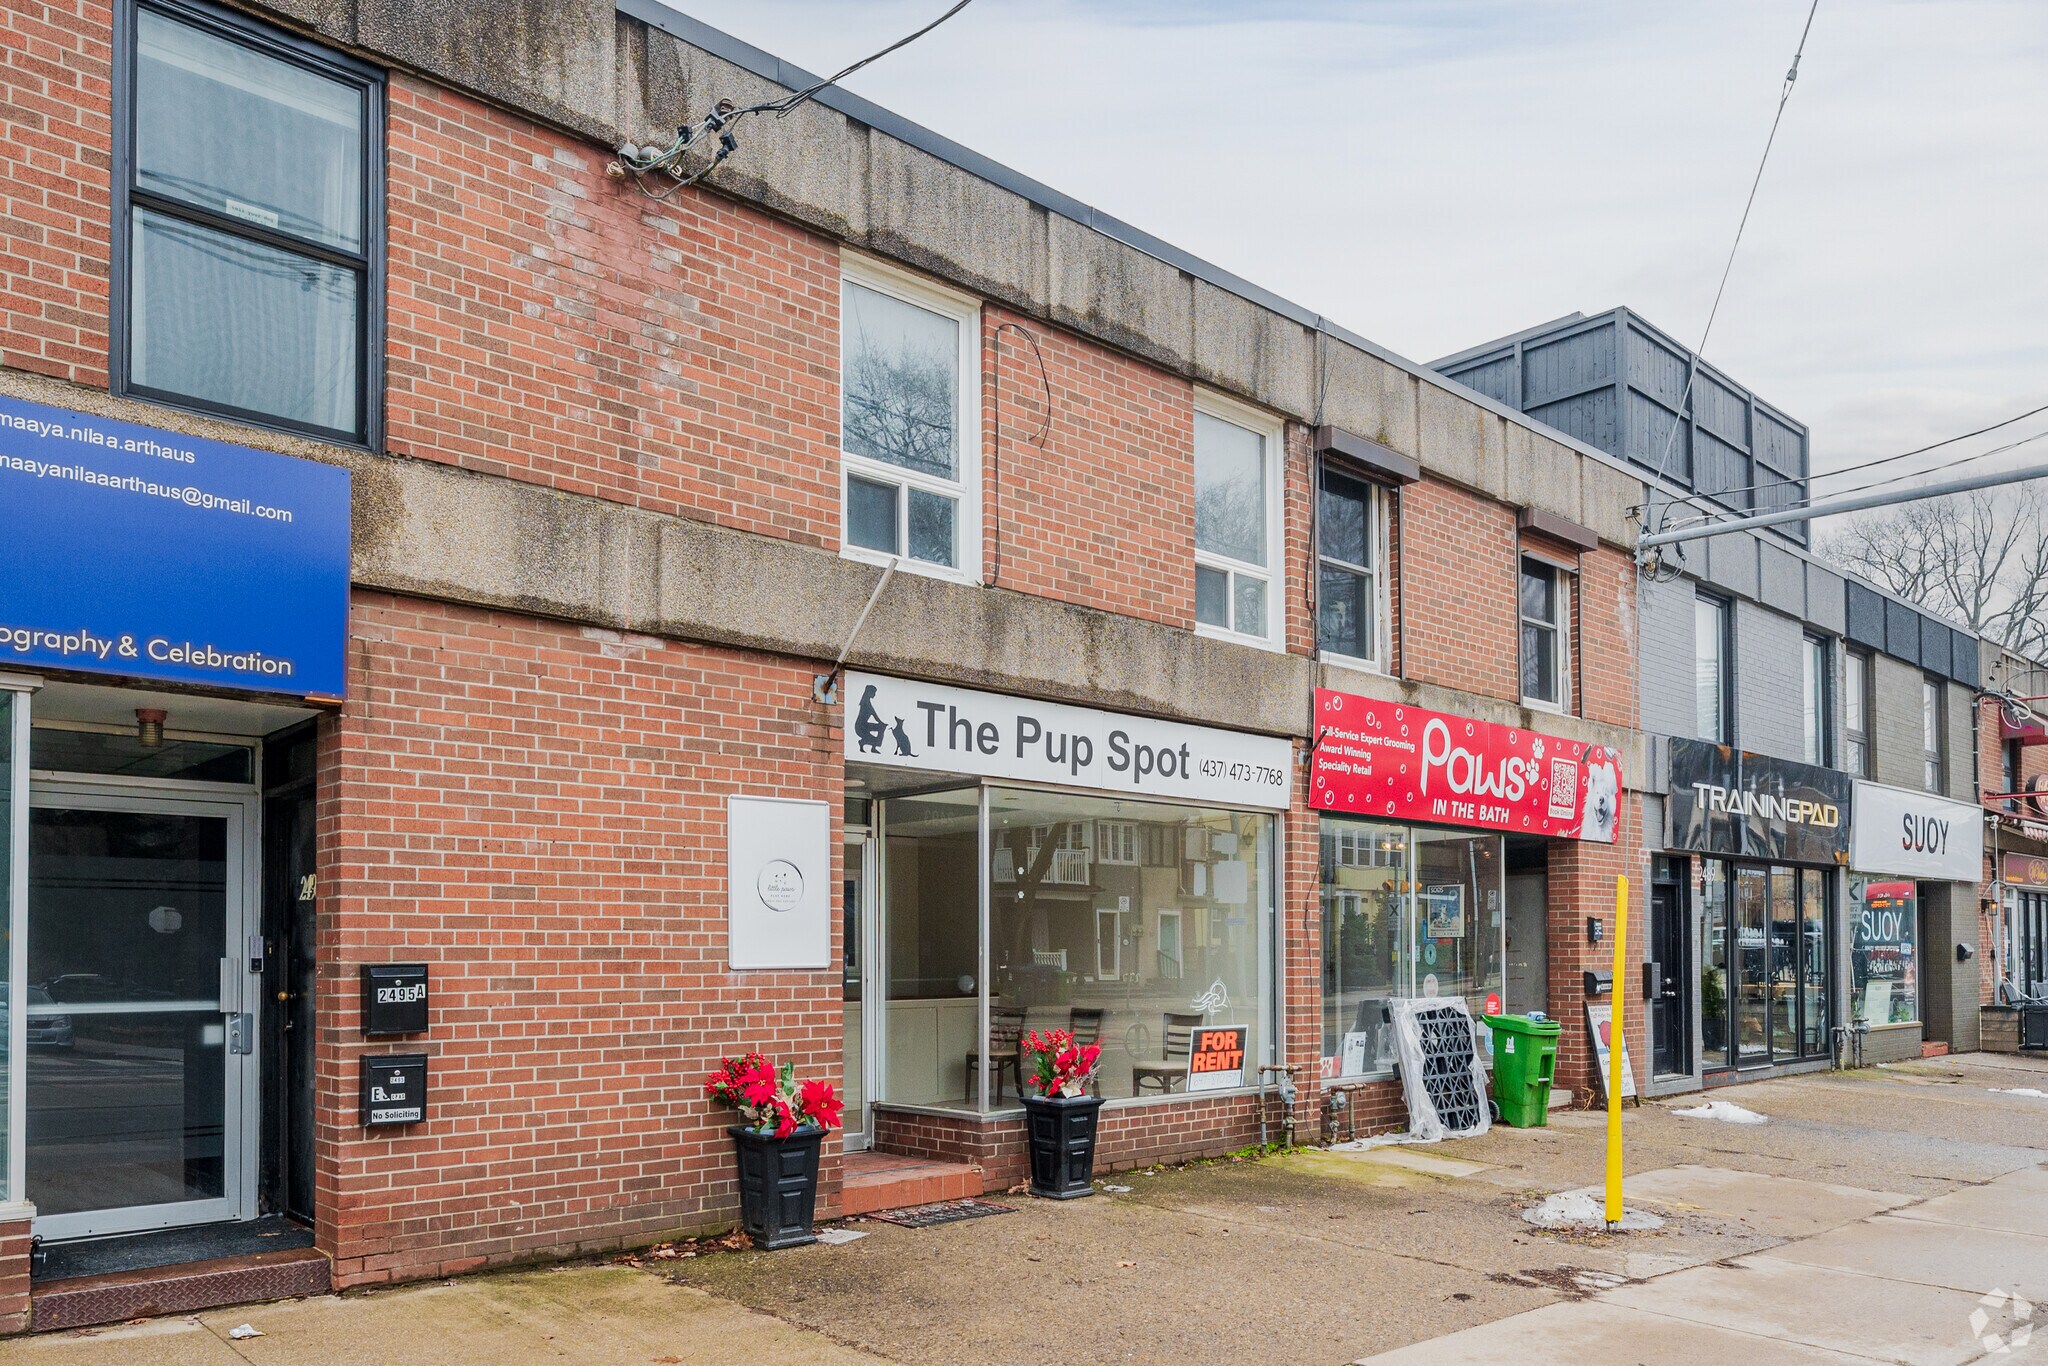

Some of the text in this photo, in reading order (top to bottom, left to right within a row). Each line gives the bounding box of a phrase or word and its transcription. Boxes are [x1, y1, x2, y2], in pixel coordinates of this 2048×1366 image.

[118, 635, 138, 657] &
[147, 638, 291, 676] Celebration
[916, 700, 1283, 786] The Pup Spot (437) 473-7768
[1319, 742, 1372, 762] Award Winning
[1360, 732, 1383, 746] Expert
[1383, 737, 1416, 754] Grooming
[1318, 758, 1372, 776] Speciality Retail
[1420, 718, 1526, 802] Paws
[1432, 798, 1510, 824] IN THE BATH
[1691, 782, 1839, 828] TRAININGPAD
[1902, 812, 1949, 856] SUOY
[1861, 910, 1903, 941] SUOY
[379, 985, 424, 1002] 2495A
[1200, 1030, 1238, 1051] FOR
[1192, 1050, 1243, 1072] RENT
[372, 1110, 419, 1120] No Soliciting
